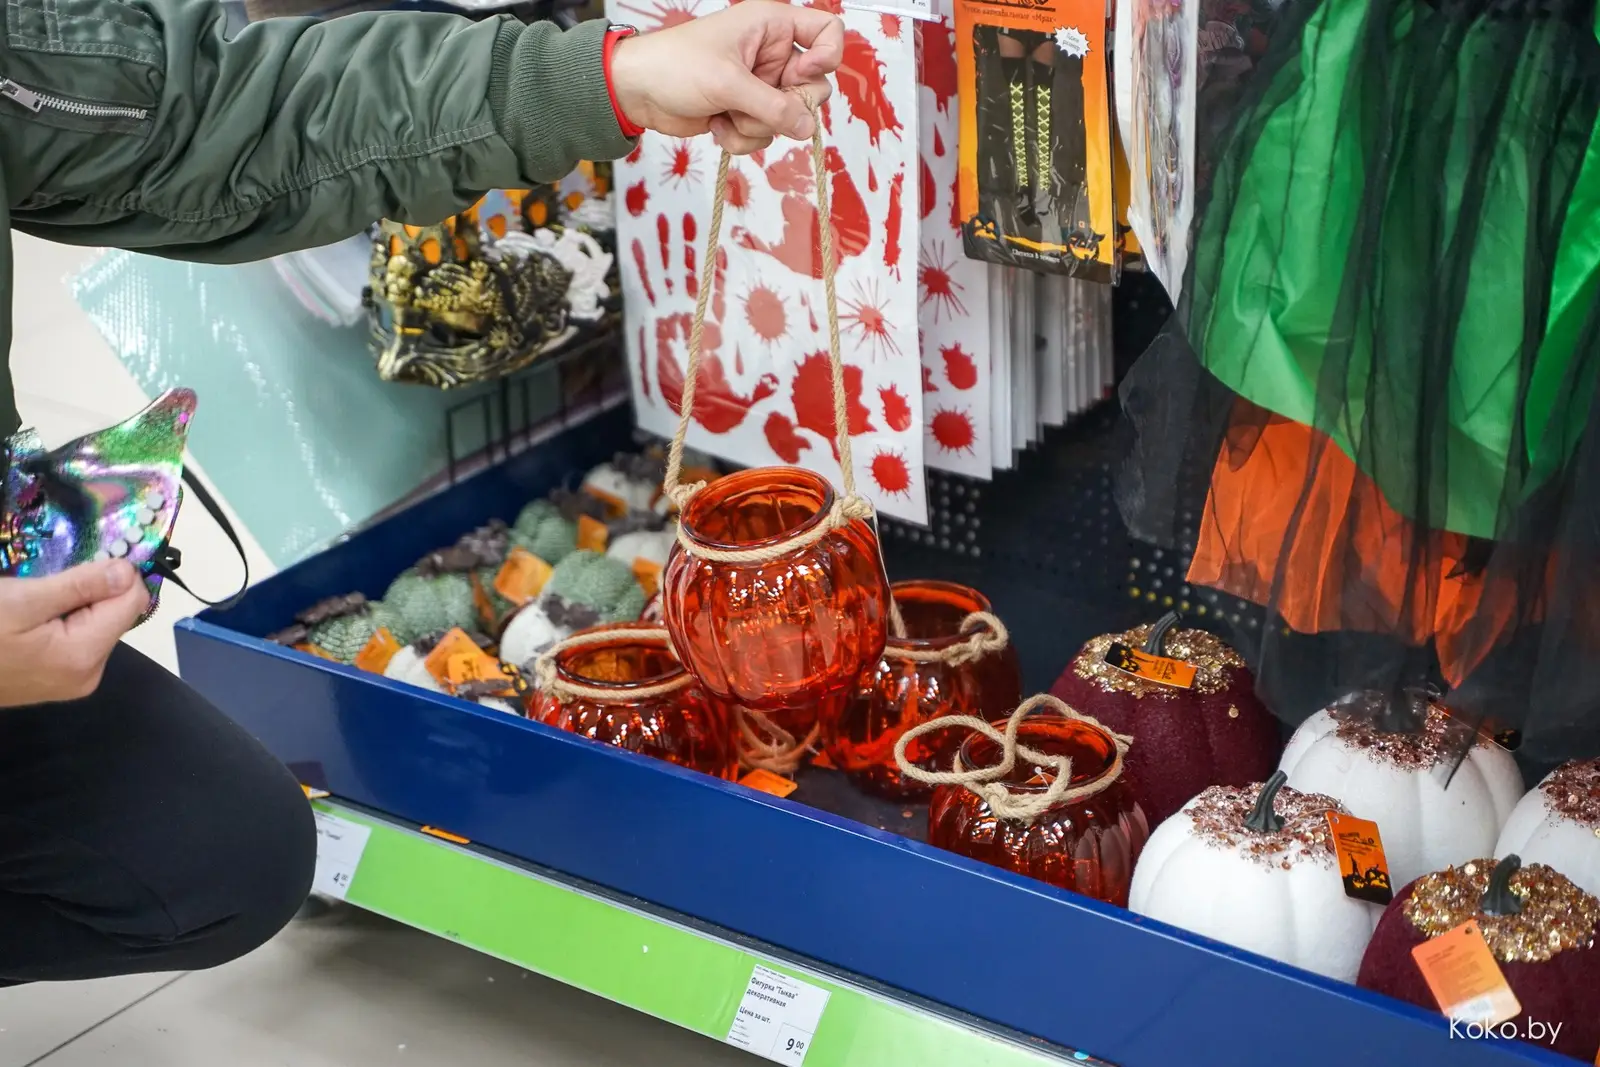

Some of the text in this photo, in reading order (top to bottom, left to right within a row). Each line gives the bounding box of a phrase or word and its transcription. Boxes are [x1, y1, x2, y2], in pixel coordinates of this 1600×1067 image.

[751, 977, 775, 992] Фигурка
[776, 986, 798, 999] "Тыква"
[746, 989, 787, 1008] декоративная
[739, 1006, 754, 1017] Цена
[761, 1016, 771, 1024] шт.
[785, 1038, 804, 1050] 9 00
